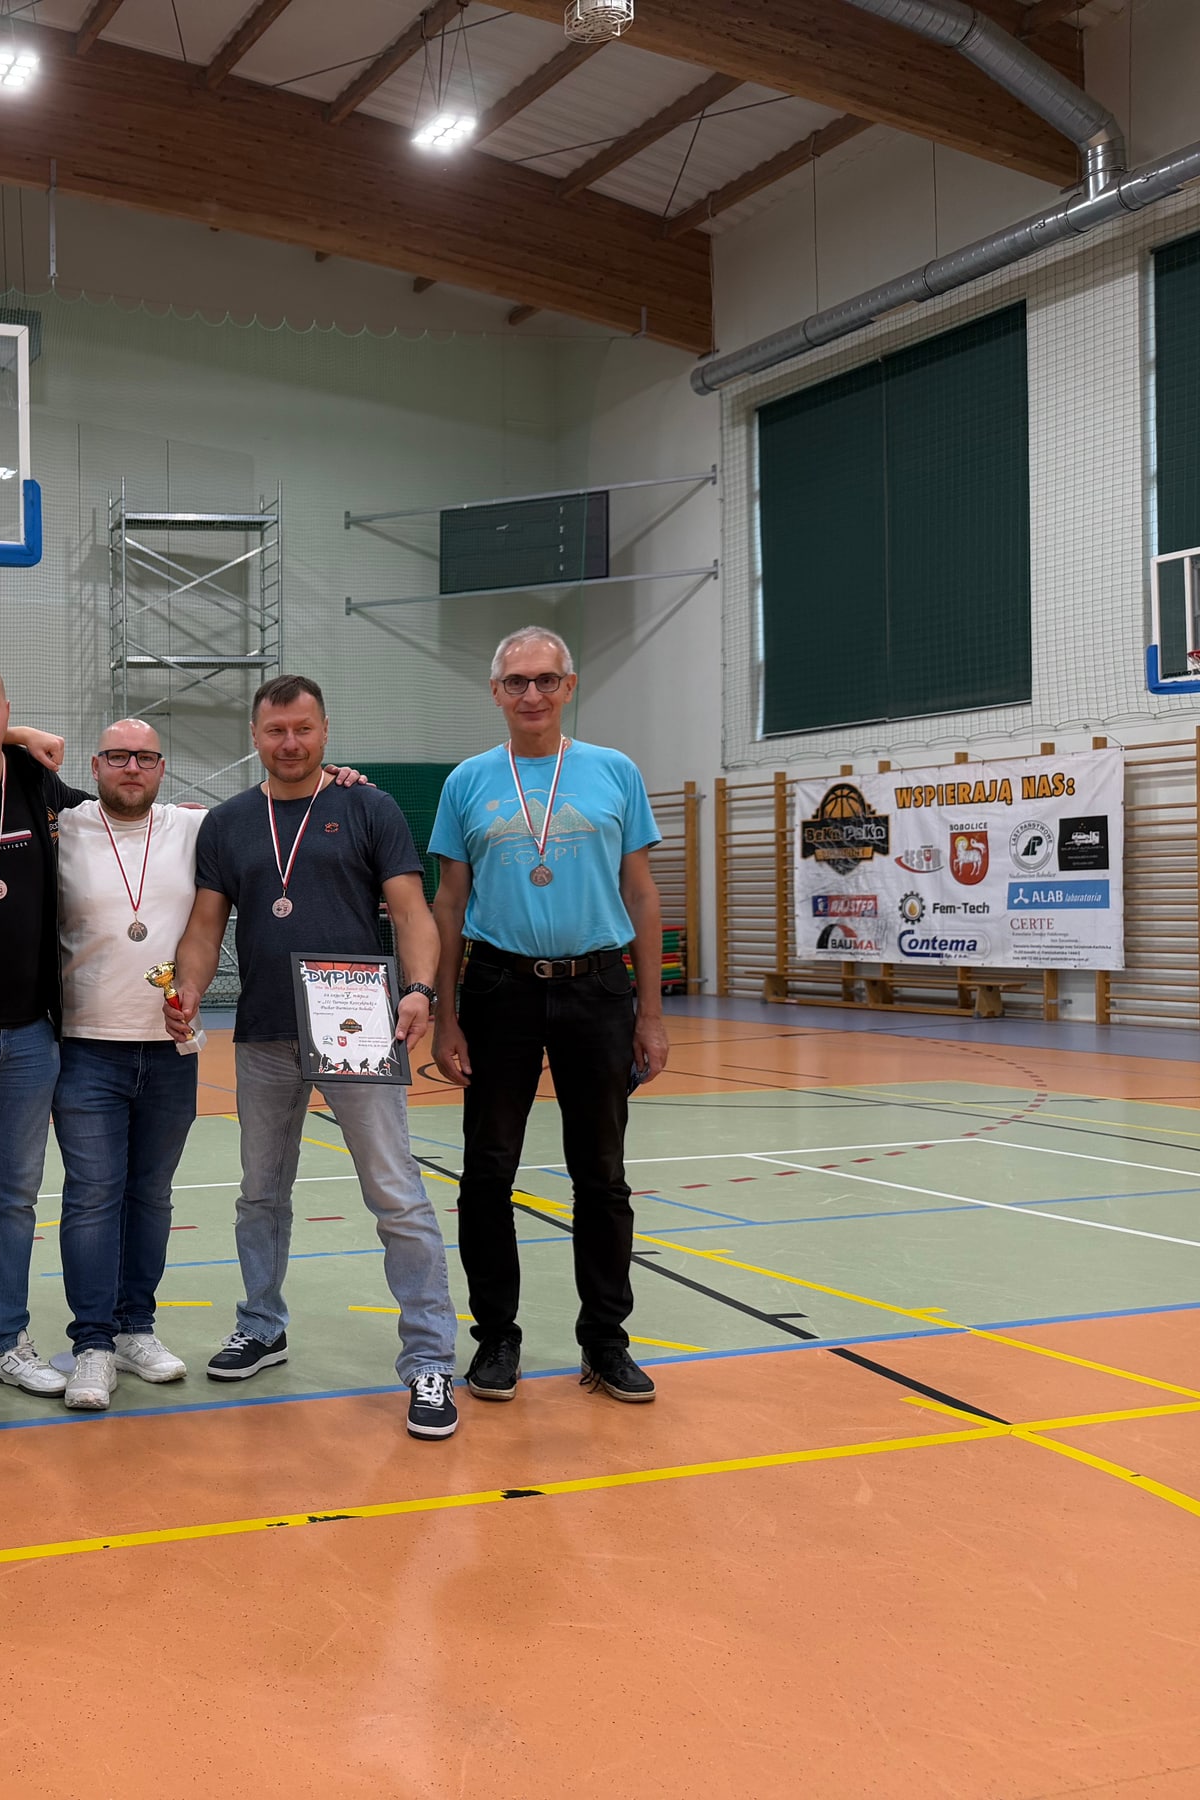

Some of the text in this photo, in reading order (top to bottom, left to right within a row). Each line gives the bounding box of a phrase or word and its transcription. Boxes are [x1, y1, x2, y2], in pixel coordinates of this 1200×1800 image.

[895, 772, 1076, 809] WSPIERAJĄ NAS:
[949, 822, 988, 831] BOBOLICE
[500, 845, 582, 865] EGYPT
[1032, 890, 1063, 903] ALAB
[932, 902, 990, 914] Fem-Tech
[1010, 917, 1054, 930] CERTE
[303, 970, 381, 988] DYPLOM
